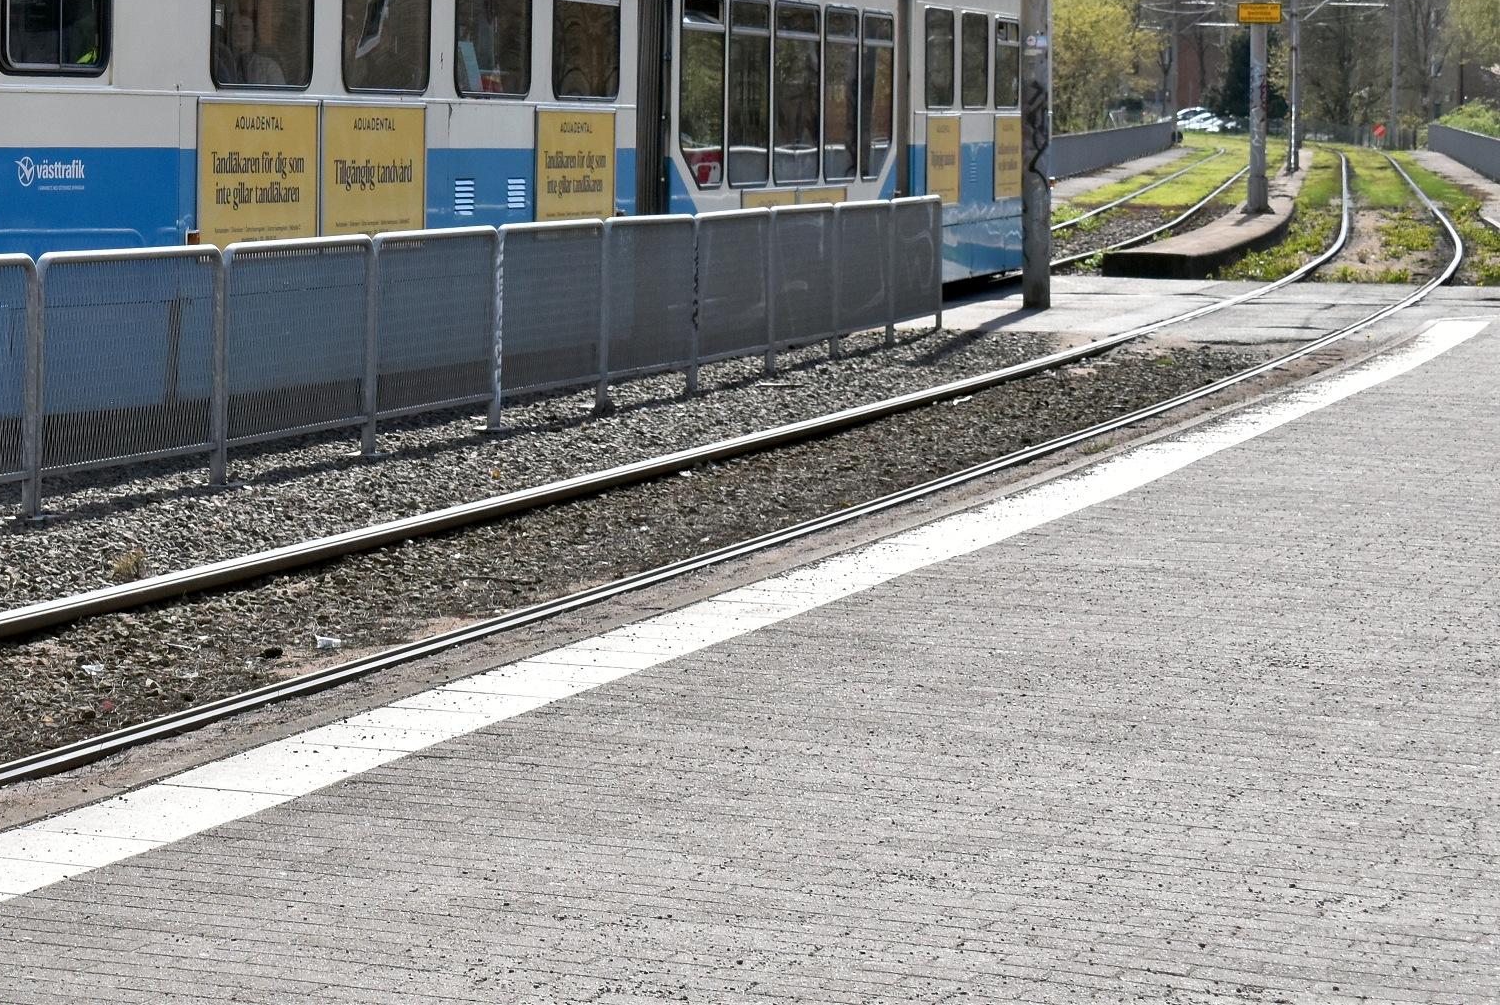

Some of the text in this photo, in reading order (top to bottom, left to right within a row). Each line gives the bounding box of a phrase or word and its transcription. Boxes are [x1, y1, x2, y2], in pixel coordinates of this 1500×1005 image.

[235, 116, 284, 131] AQUADENTAL
[353, 117, 396, 132] AQUADENTAL
[36, 159, 85, 179] västtrafik
[211, 151, 304, 179] Tandläkaren för dig som
[334, 158, 413, 191] Tillgänglig tandvård
[216, 181, 300, 210] inte gillar tandläkaren
